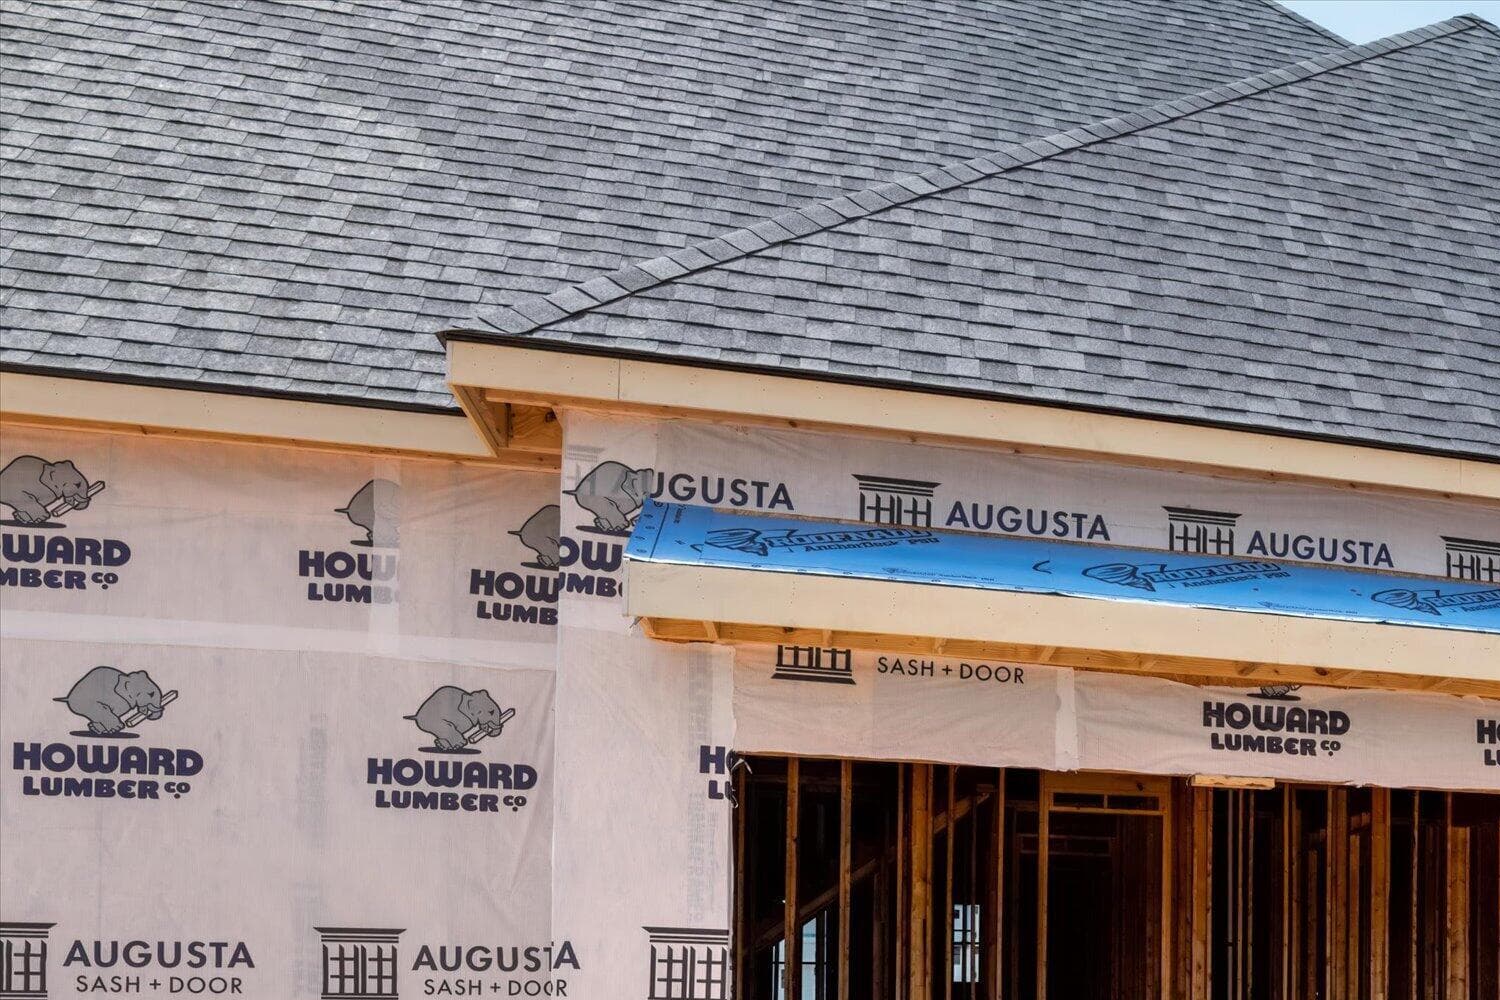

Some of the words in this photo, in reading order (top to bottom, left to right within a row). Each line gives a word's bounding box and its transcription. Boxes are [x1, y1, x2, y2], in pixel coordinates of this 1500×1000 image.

[945, 500, 1111, 541] AUGUSTA
[1246, 530, 1395, 568] AUGUSTA
[476, 601, 559, 626] LUMB
[876, 656, 935, 679] SASH
[959, 661, 1025, 685] DOOR
[1202, 699, 1351, 737] HOWARD
[1211, 731, 1317, 757] LUMBER
[12, 741, 204, 777] HOWARD
[366, 757, 538, 790] HOWARD
[22, 775, 159, 801] LUMBER
[374, 787, 499, 812] LUMBER
[63, 939, 256, 969] AUGUSTA
[411, 940, 581, 972] AUGUSTA
[75, 975, 142, 995] SASH
[169, 975, 243, 994] DOOR
[423, 978, 483, 996] SASH
[508, 979, 568, 997] DOOR
